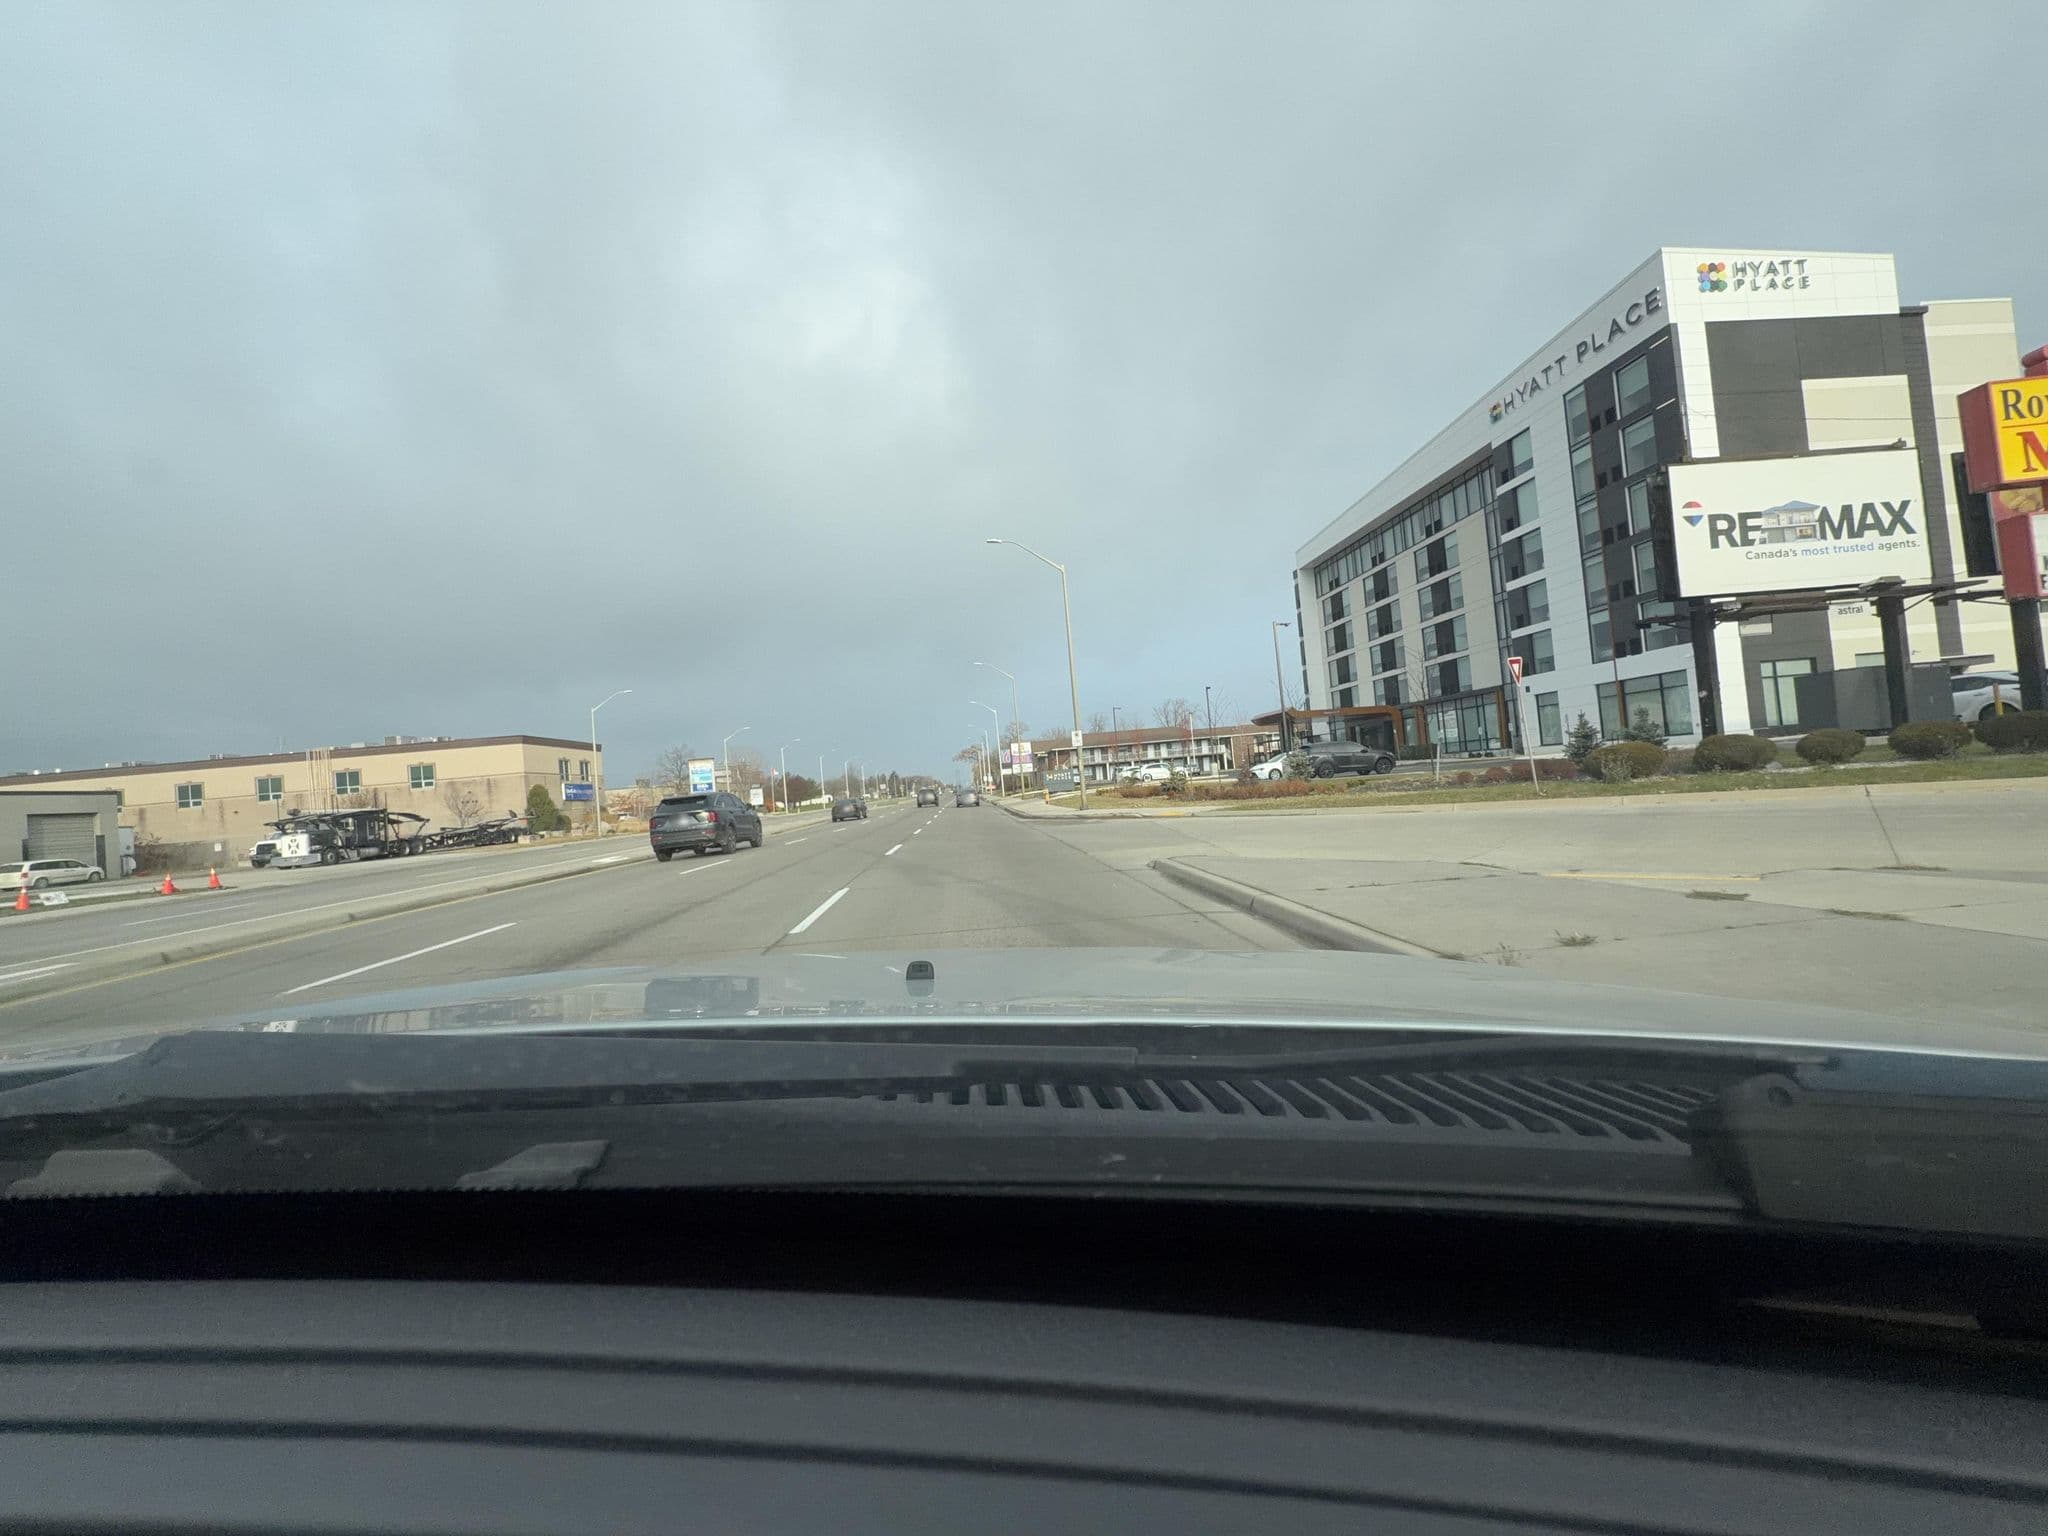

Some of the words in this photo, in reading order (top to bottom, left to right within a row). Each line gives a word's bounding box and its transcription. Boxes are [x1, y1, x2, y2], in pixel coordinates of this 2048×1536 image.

[1731, 259, 1808, 278] HYATT
[1733, 276, 1811, 291] PLACE
[1503, 354, 1568, 414] HYATT
[1576, 286, 1662, 364] PLACE
[1999, 388, 2048, 421] Ro
[1816, 499, 1917, 541] MAX
[1745, 547, 1798, 560] Canada's
[1801, 546, 1830, 557] most
[1833, 542, 1874, 554] trusted
[1878, 539, 1921, 552] agents.
[1837, 605, 1864, 615] astral
